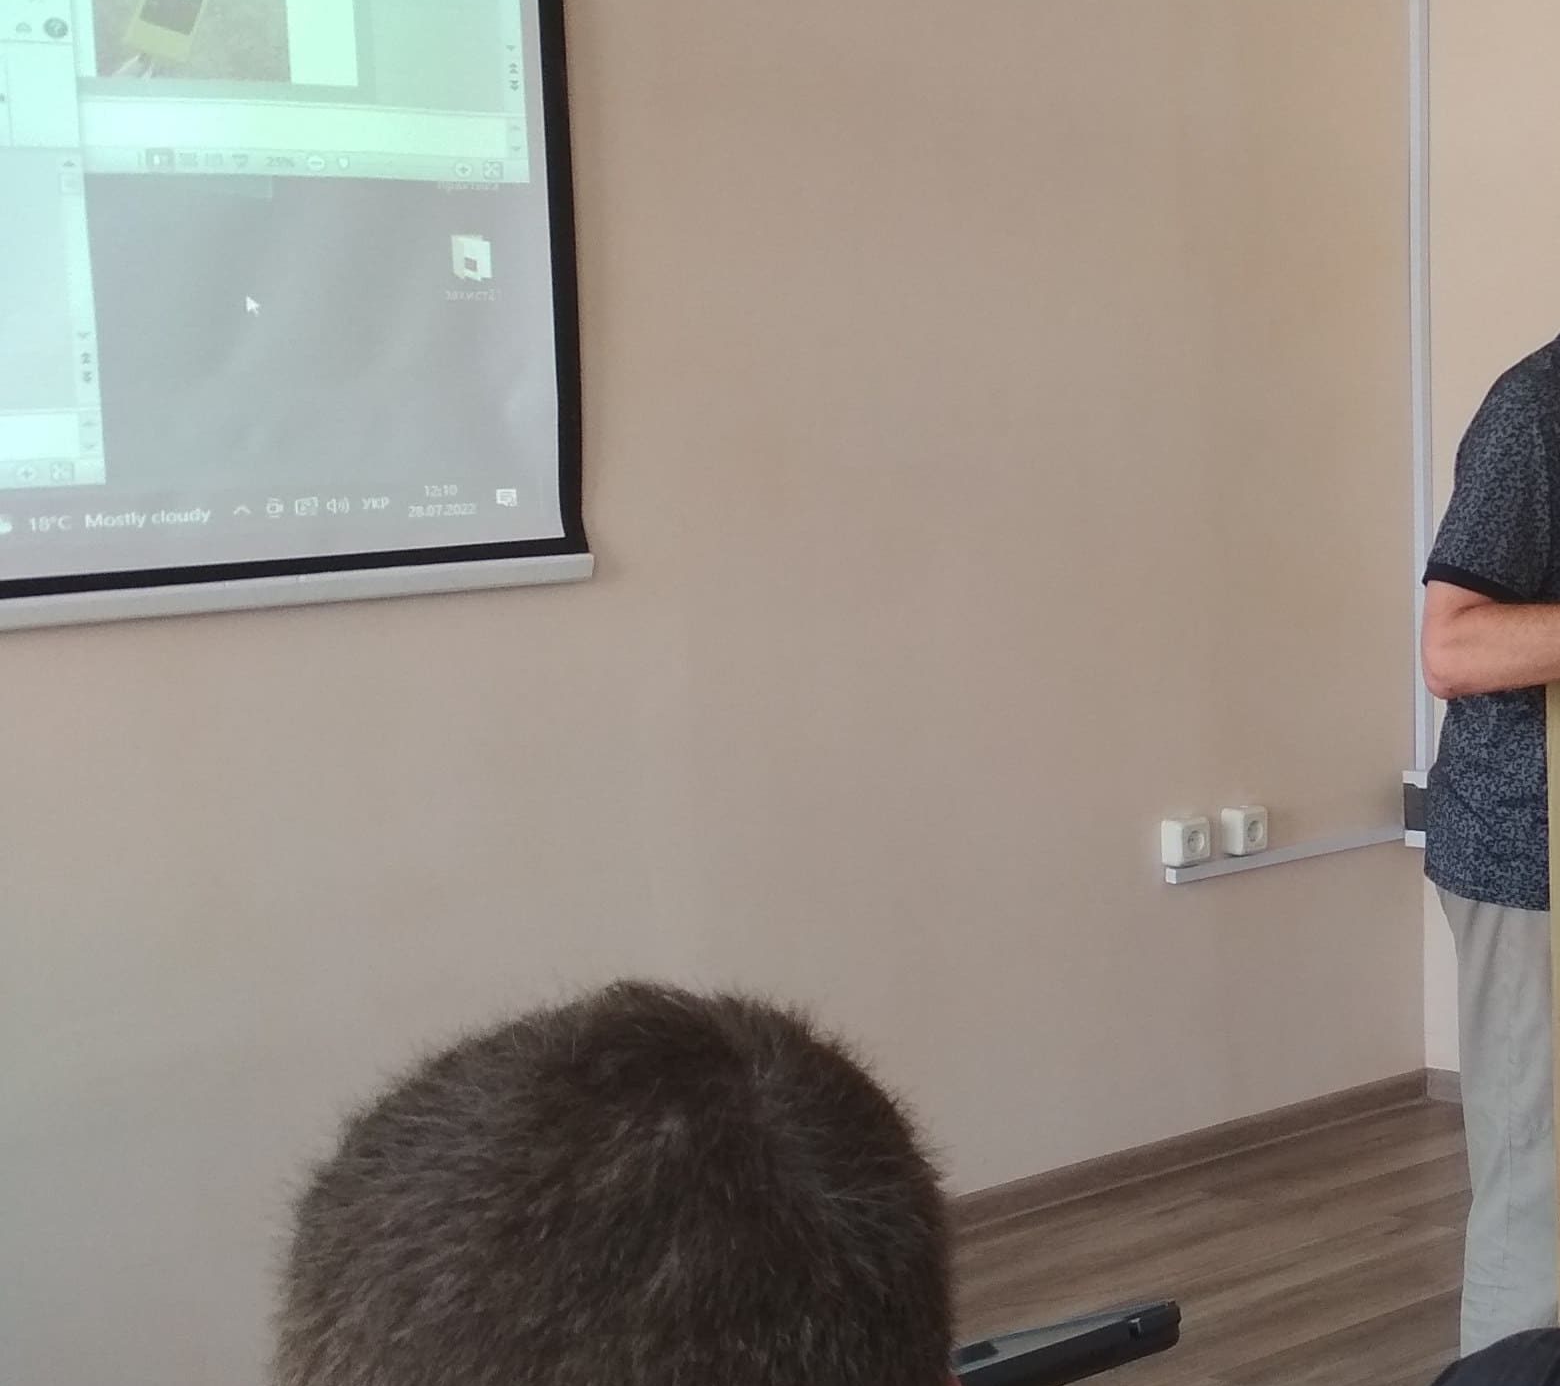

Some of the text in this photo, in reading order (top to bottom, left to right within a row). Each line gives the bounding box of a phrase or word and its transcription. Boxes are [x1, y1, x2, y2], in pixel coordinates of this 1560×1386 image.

[28, 508, 212, 533] 18°C Mostly cloudy
